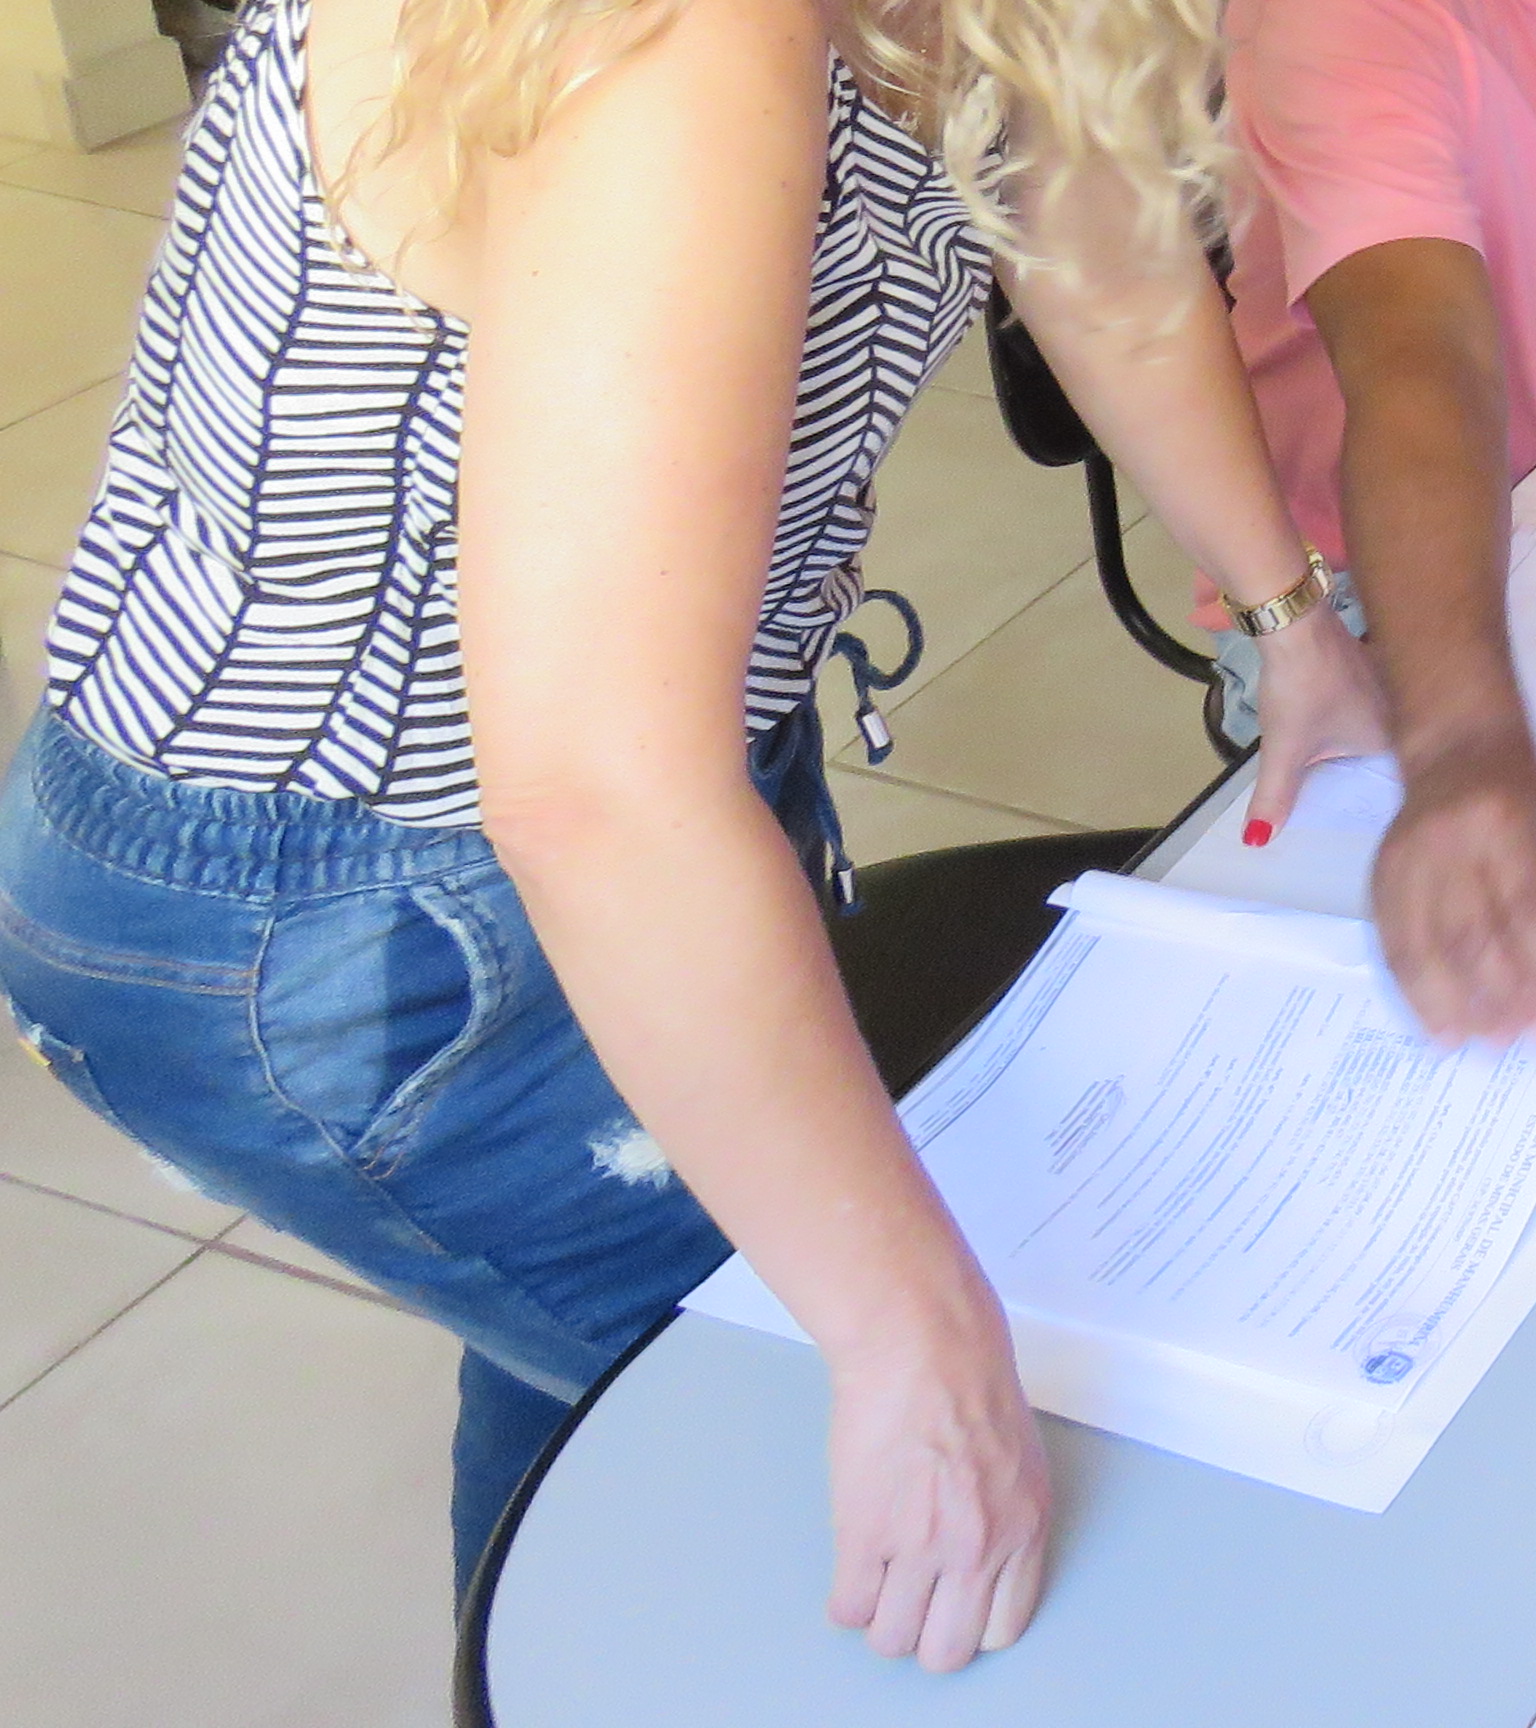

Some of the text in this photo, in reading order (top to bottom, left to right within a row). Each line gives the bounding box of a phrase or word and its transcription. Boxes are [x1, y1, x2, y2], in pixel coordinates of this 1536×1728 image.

[1500, 1164, 1516, 1183] DE
[1476, 1183, 1506, 1226] MINAS
[1451, 1226, 1482, 1271] GERAIS
[1474, 1238, 1494, 1259] DE
